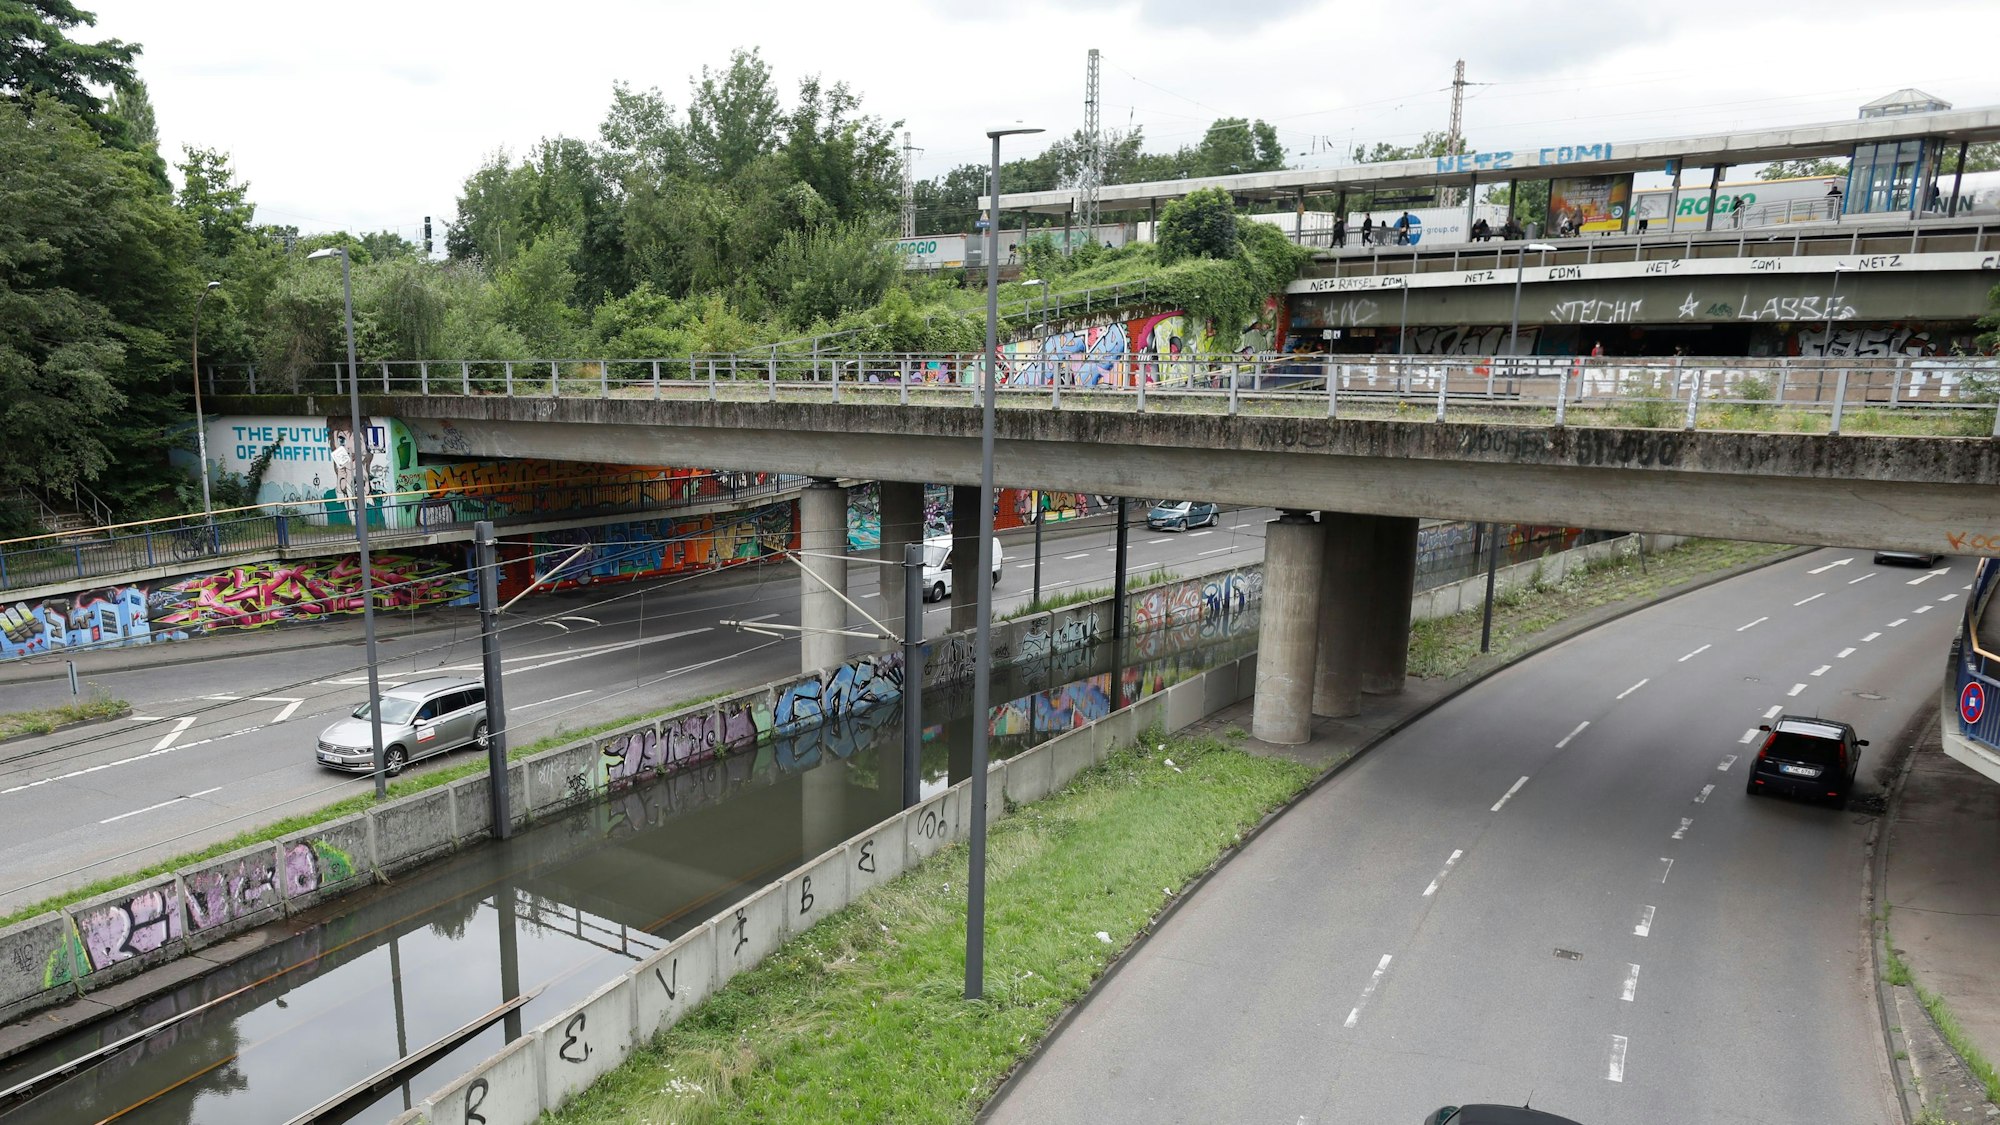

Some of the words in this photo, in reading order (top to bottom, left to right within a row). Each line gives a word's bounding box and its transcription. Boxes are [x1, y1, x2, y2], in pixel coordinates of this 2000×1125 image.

[1310, 279, 1335, 292] NETZ
[1464, 271, 1494, 284] NETZ
[1858, 255, 1900, 270] NETZ
[232, 426, 273, 442] THE
[236, 444, 256, 460] OF
